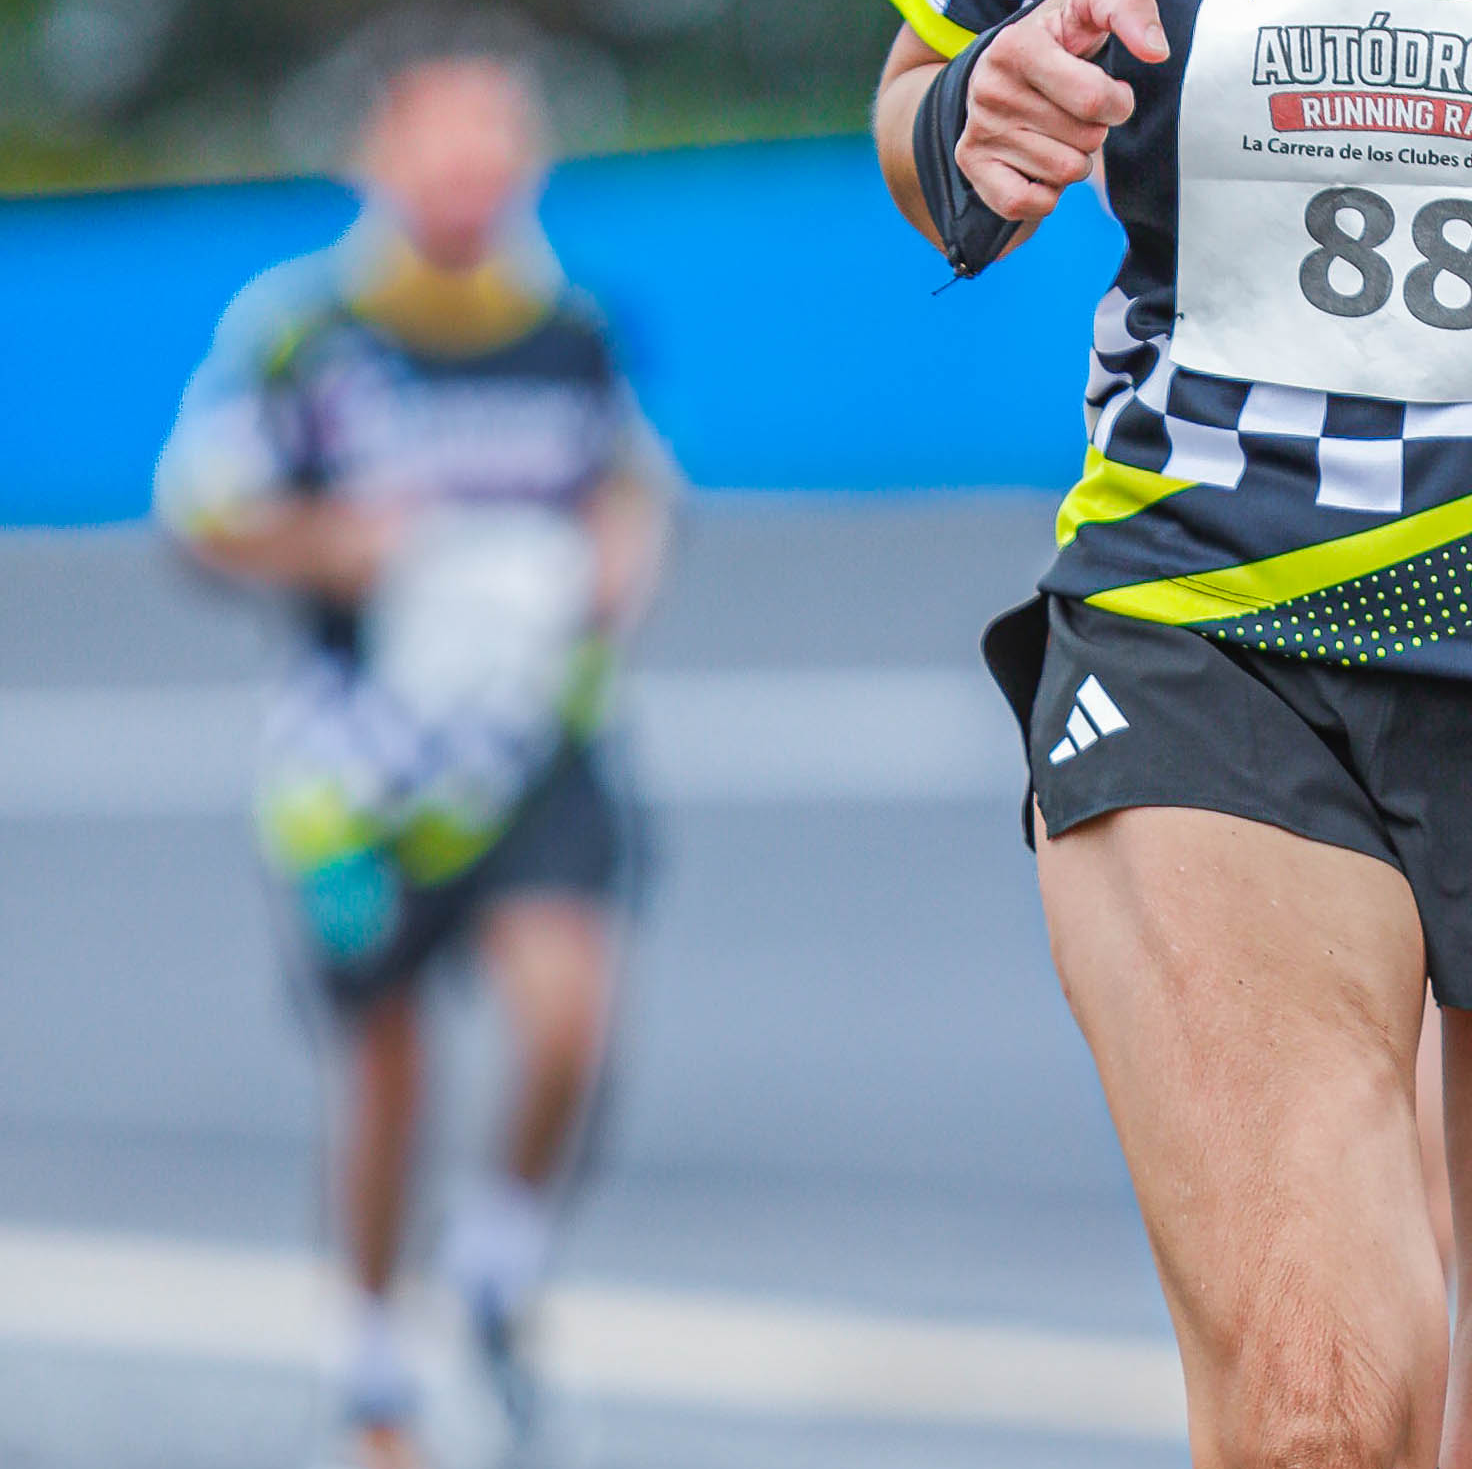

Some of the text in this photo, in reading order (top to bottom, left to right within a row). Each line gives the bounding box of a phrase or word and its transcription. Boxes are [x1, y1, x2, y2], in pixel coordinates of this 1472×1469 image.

[1301, 95, 1436, 132] RUNNING
[1242, 134, 1263, 152] La
[1267, 137, 1334, 159] Carrera
[1339, 144, 1363, 161] de
[1367, 145, 1394, 163] los
[1398, 148, 1460, 168] Clubes
